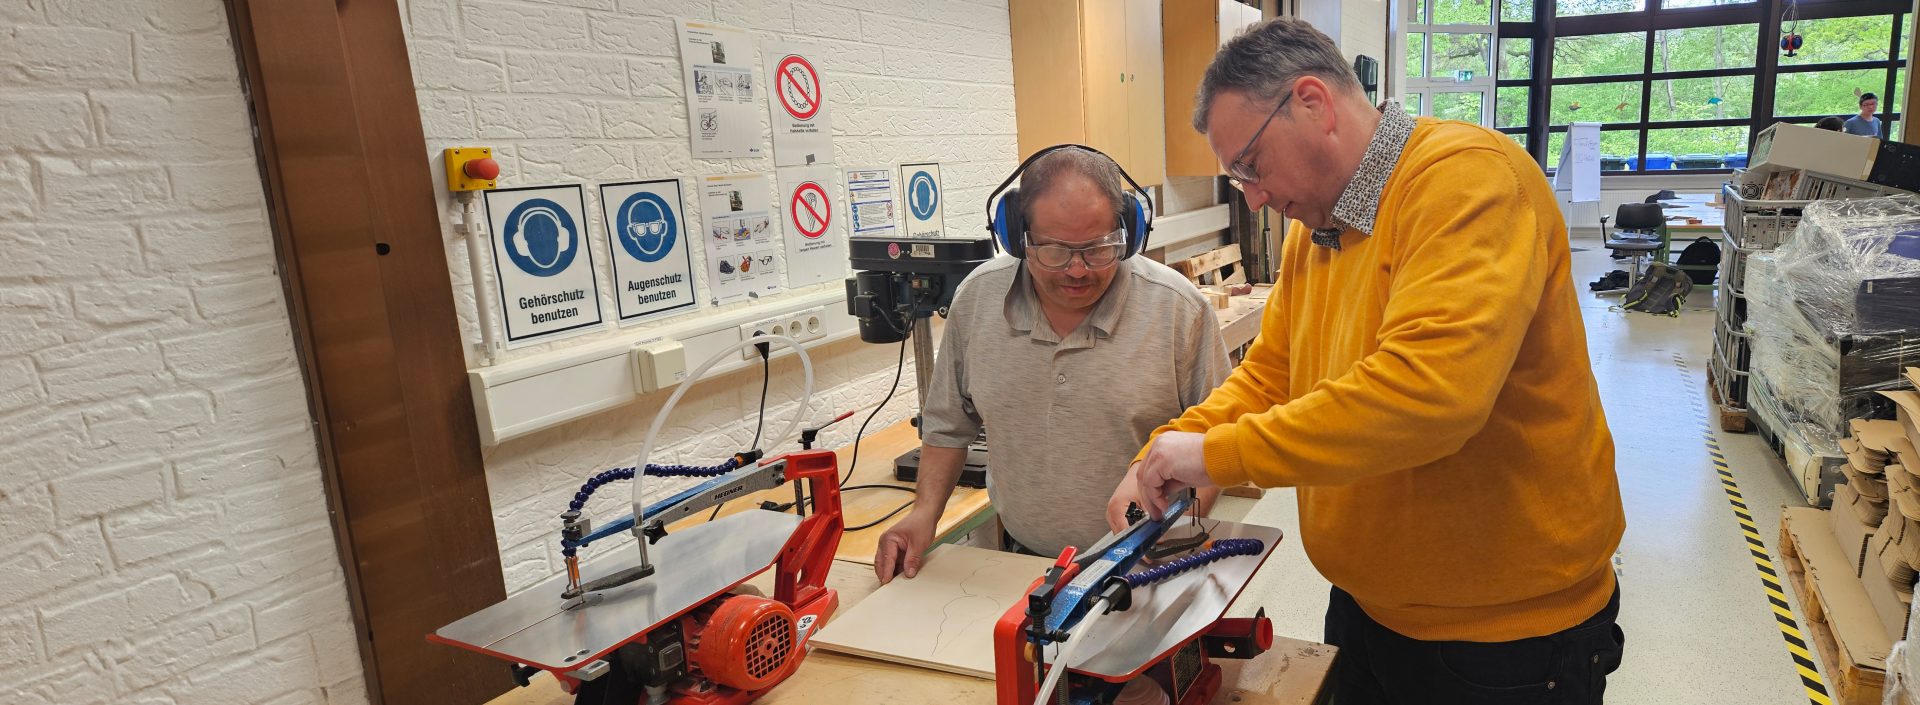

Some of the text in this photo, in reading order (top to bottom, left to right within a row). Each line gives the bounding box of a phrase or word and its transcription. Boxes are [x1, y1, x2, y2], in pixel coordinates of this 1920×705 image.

[628, 273, 682, 291] Augenschutz
[519, 289, 585, 309] Gehörschutz
[637, 289, 677, 305] benutzen
[531, 307, 579, 324] benutzen
[714, 485, 743, 500] HEGNER
